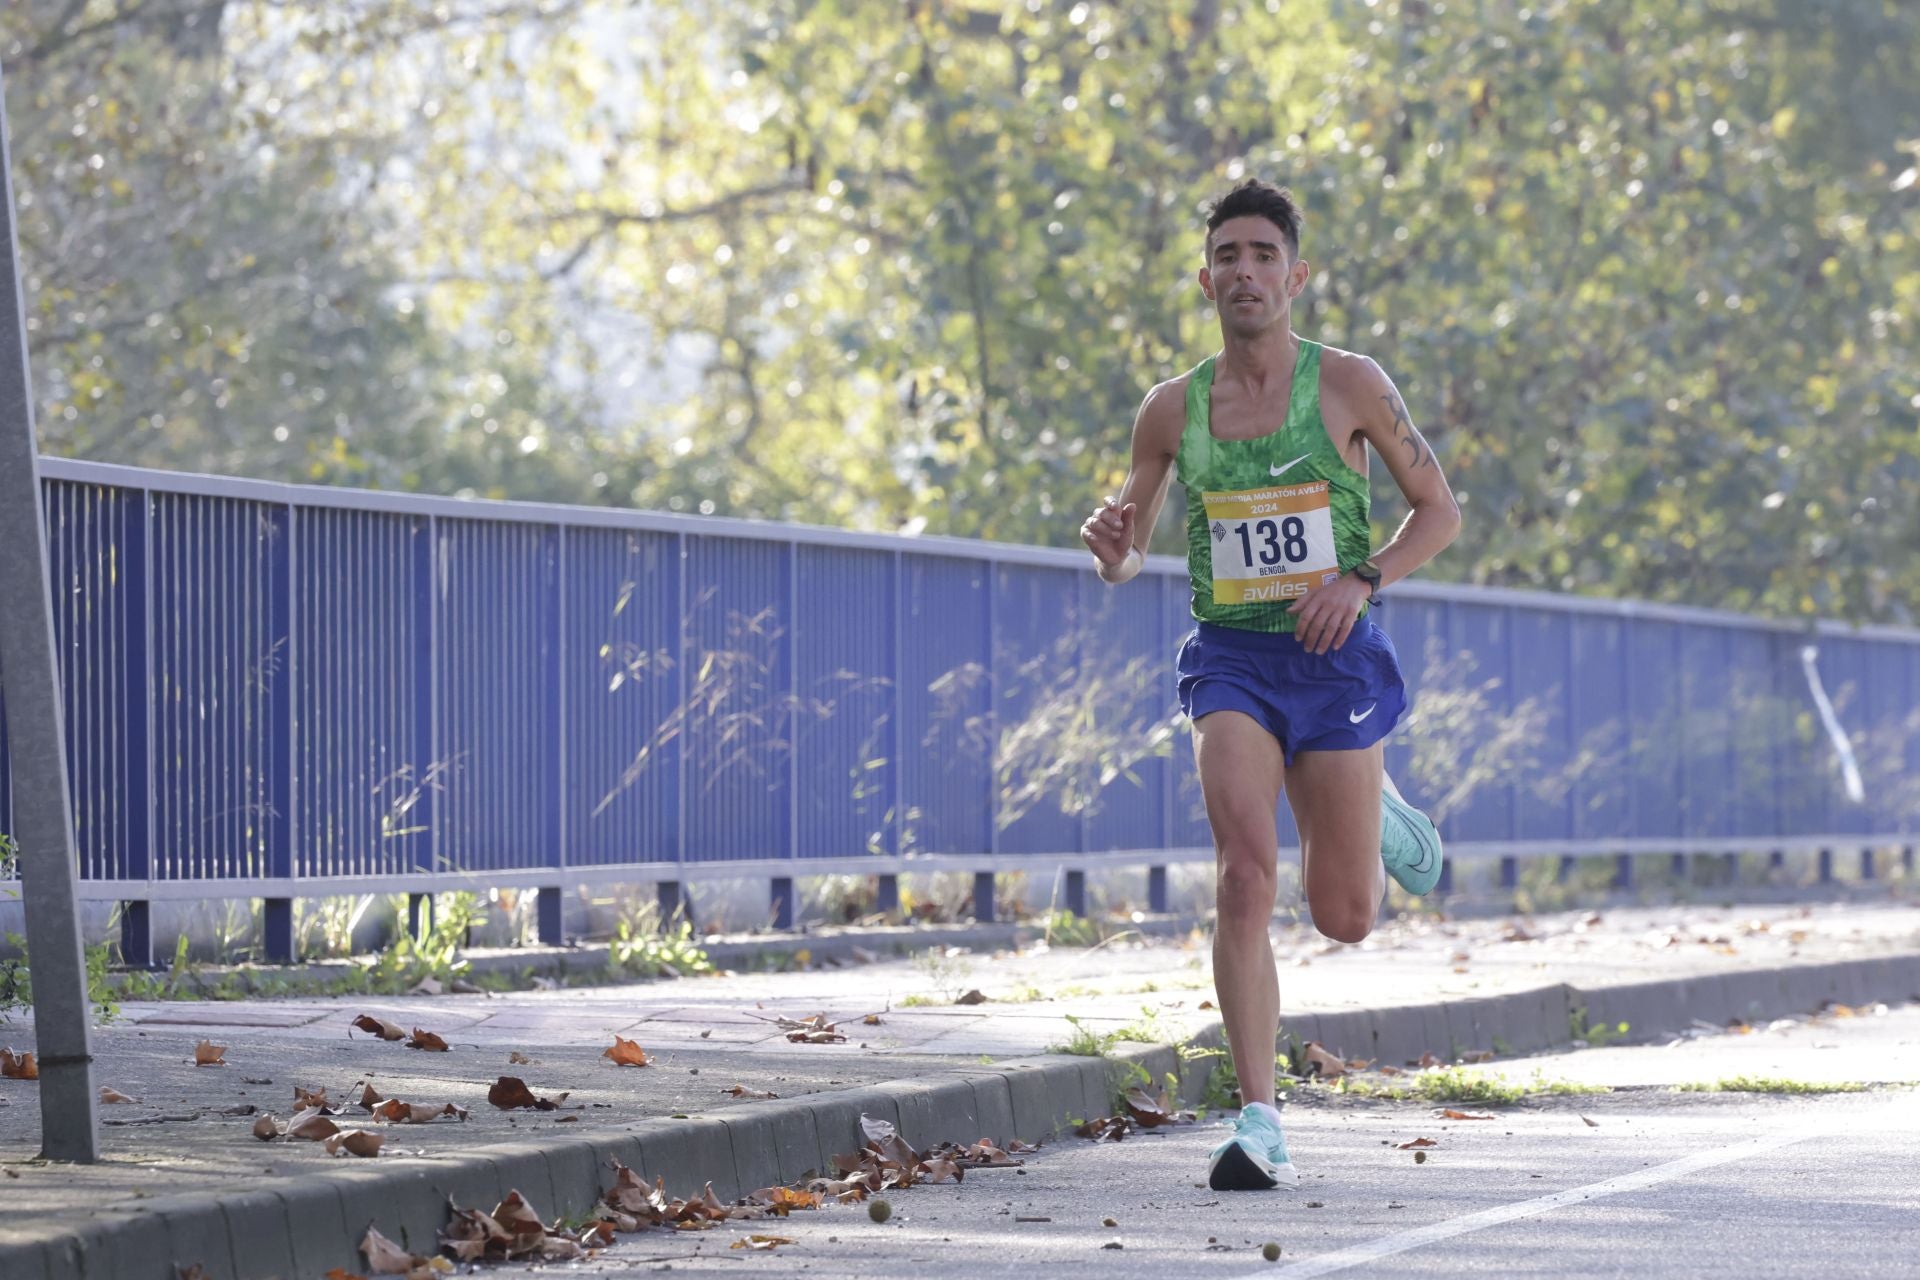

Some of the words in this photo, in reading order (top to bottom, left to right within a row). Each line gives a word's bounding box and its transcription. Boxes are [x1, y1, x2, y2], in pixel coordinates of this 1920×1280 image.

[1227, 494, 1252, 503] MEDIA
[1254, 489, 1296, 502] MARATÓN
[1298, 484, 1325, 496] AVILÉS
[1251, 503, 1278, 514] 2024
[1235, 516, 1308, 568] 138
[1259, 565, 1287, 577] BENGOA
[1243, 580, 1309, 601] avilés
